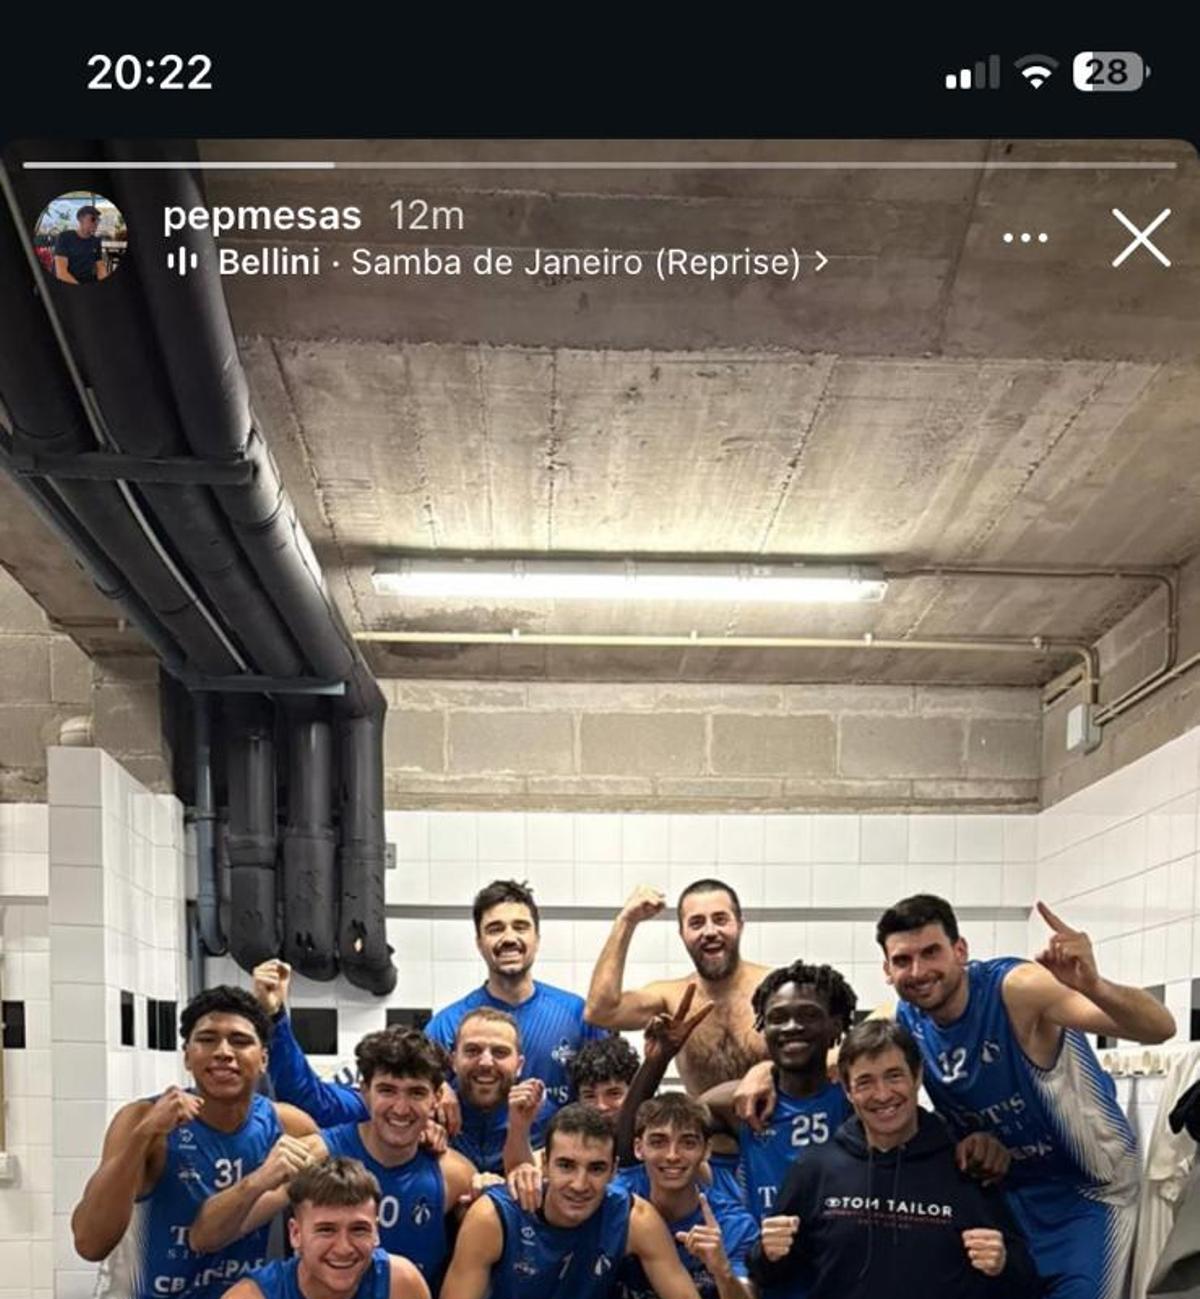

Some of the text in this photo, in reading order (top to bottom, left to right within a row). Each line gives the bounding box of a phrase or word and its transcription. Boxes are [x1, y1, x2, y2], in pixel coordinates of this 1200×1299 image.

[938, 1049, 968, 1083] 12
[791, 1111, 829, 1147] 25
[214, 1158, 243, 1188] 31
[887, 1199, 953, 1217] TAILOR
[154, 1275, 187, 1294] CB
